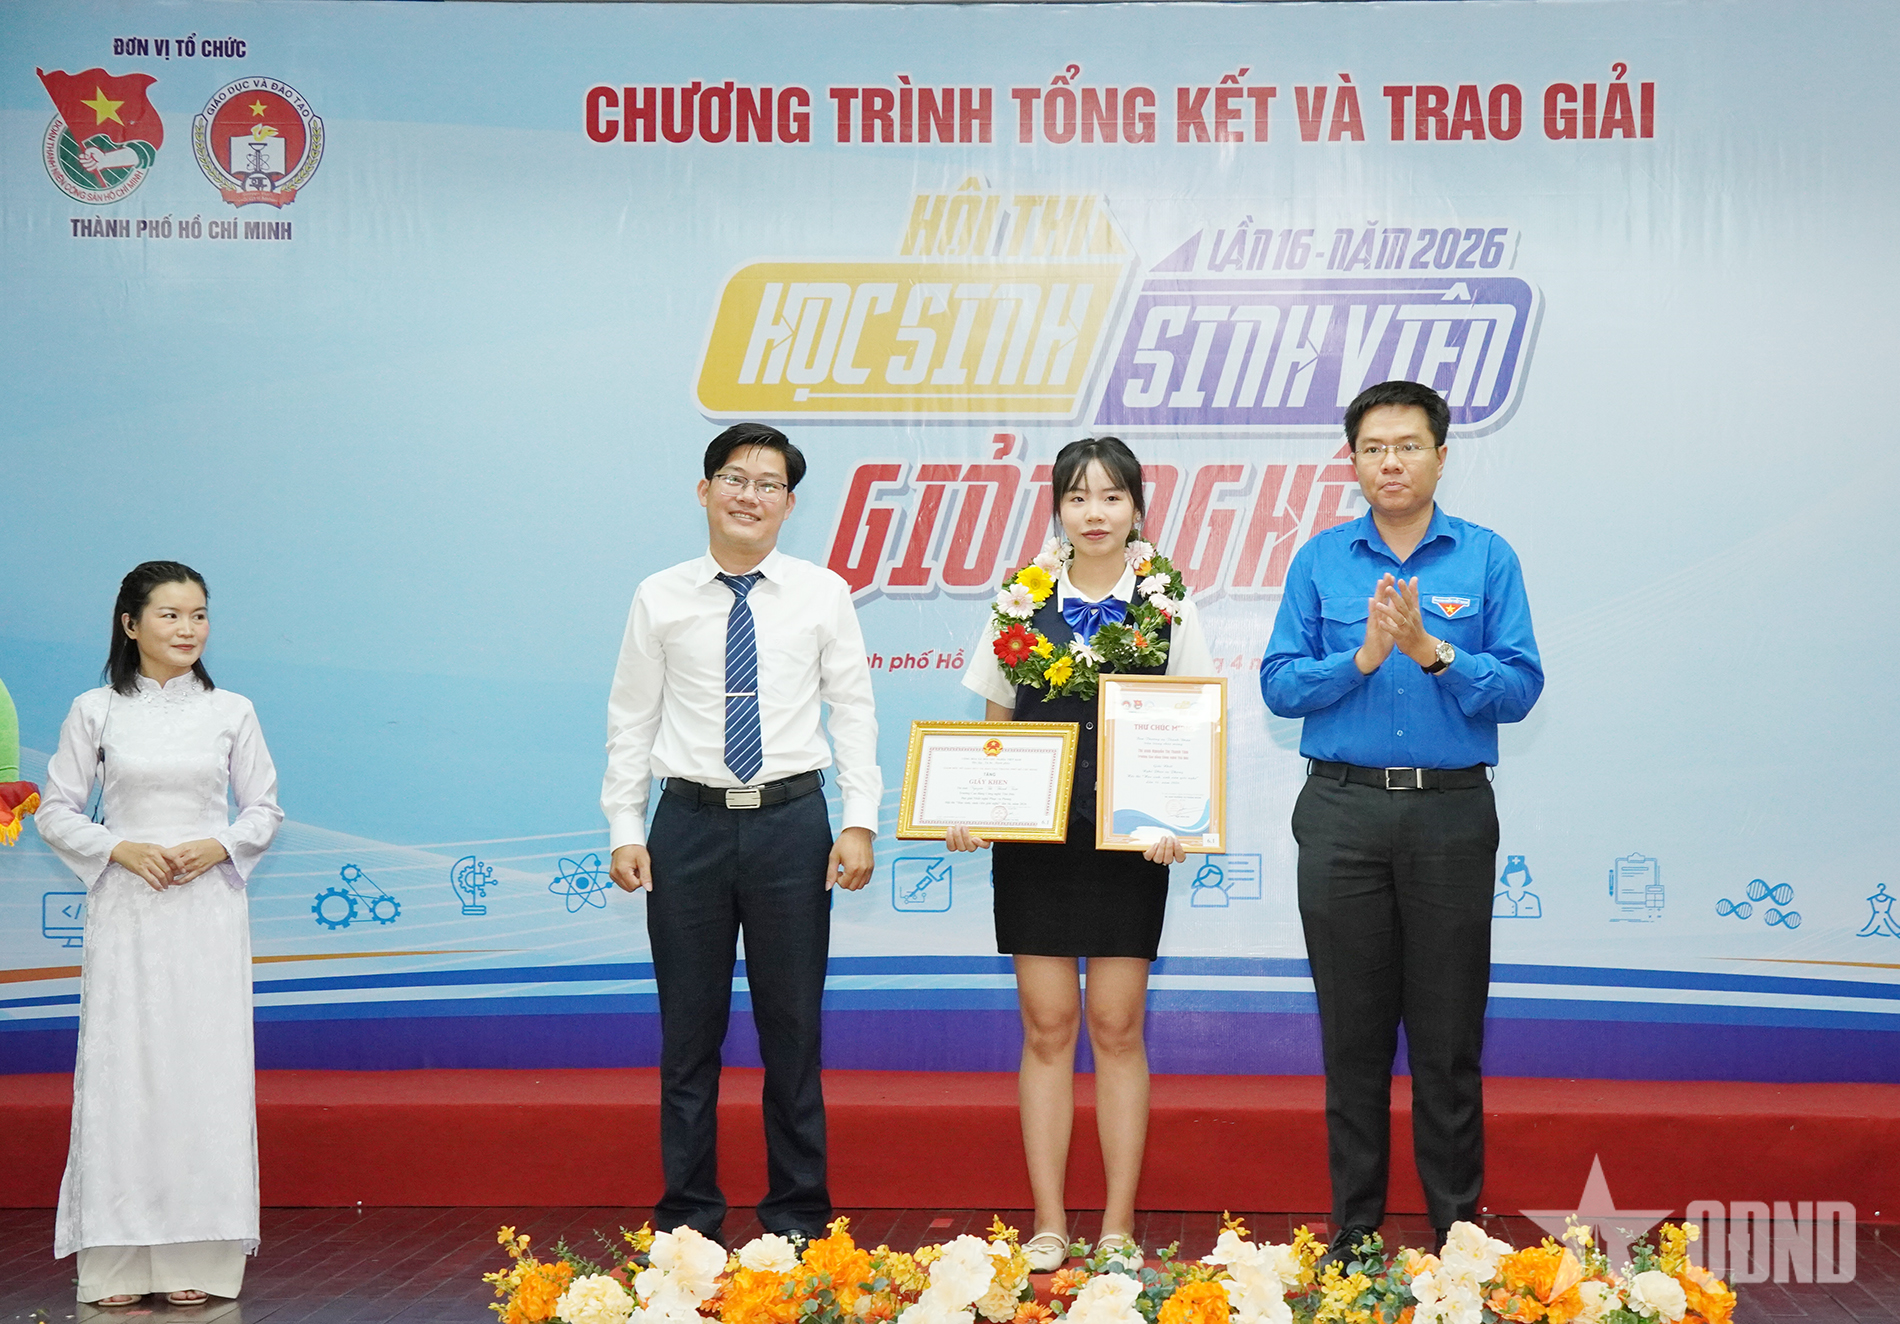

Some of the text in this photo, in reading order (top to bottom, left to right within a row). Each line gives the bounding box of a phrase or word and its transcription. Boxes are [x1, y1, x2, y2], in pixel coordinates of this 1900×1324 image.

[113, 33, 247, 61] ĐƠN VỊ TỔ CHỨC
[206, 78, 310, 118] GIÁO DỤC VÀ ĐÀO TẠO
[585, 62, 1655, 144] CHƯƠNG TRÌNH TỔNG KẾT VÀ TRAO GIẢI
[46, 142, 57, 167] THANH
[128, 170, 144, 191] MINH
[70, 213, 292, 241] THÀNH PHỐ HỒ CHÍ MINH
[900, 176, 1098, 257] HỘI THI
[1206, 214, 1274, 272] LẦN
[1271, 228, 1315, 271] 16
[1326, 219, 1413, 272] NĂM
[1411, 227, 1510, 271] 2026
[737, 281, 1094, 402] HỌC SINH
[1121, 281, 1517, 409] SINH VIÊN
[888, 648, 934, 673] phố
[935, 647, 965, 670] Hồ
[1230, 654, 1244, 671] 4
[1134, 723, 1150, 731] THƯ
[1150, 723, 1171, 732] CHÚC
